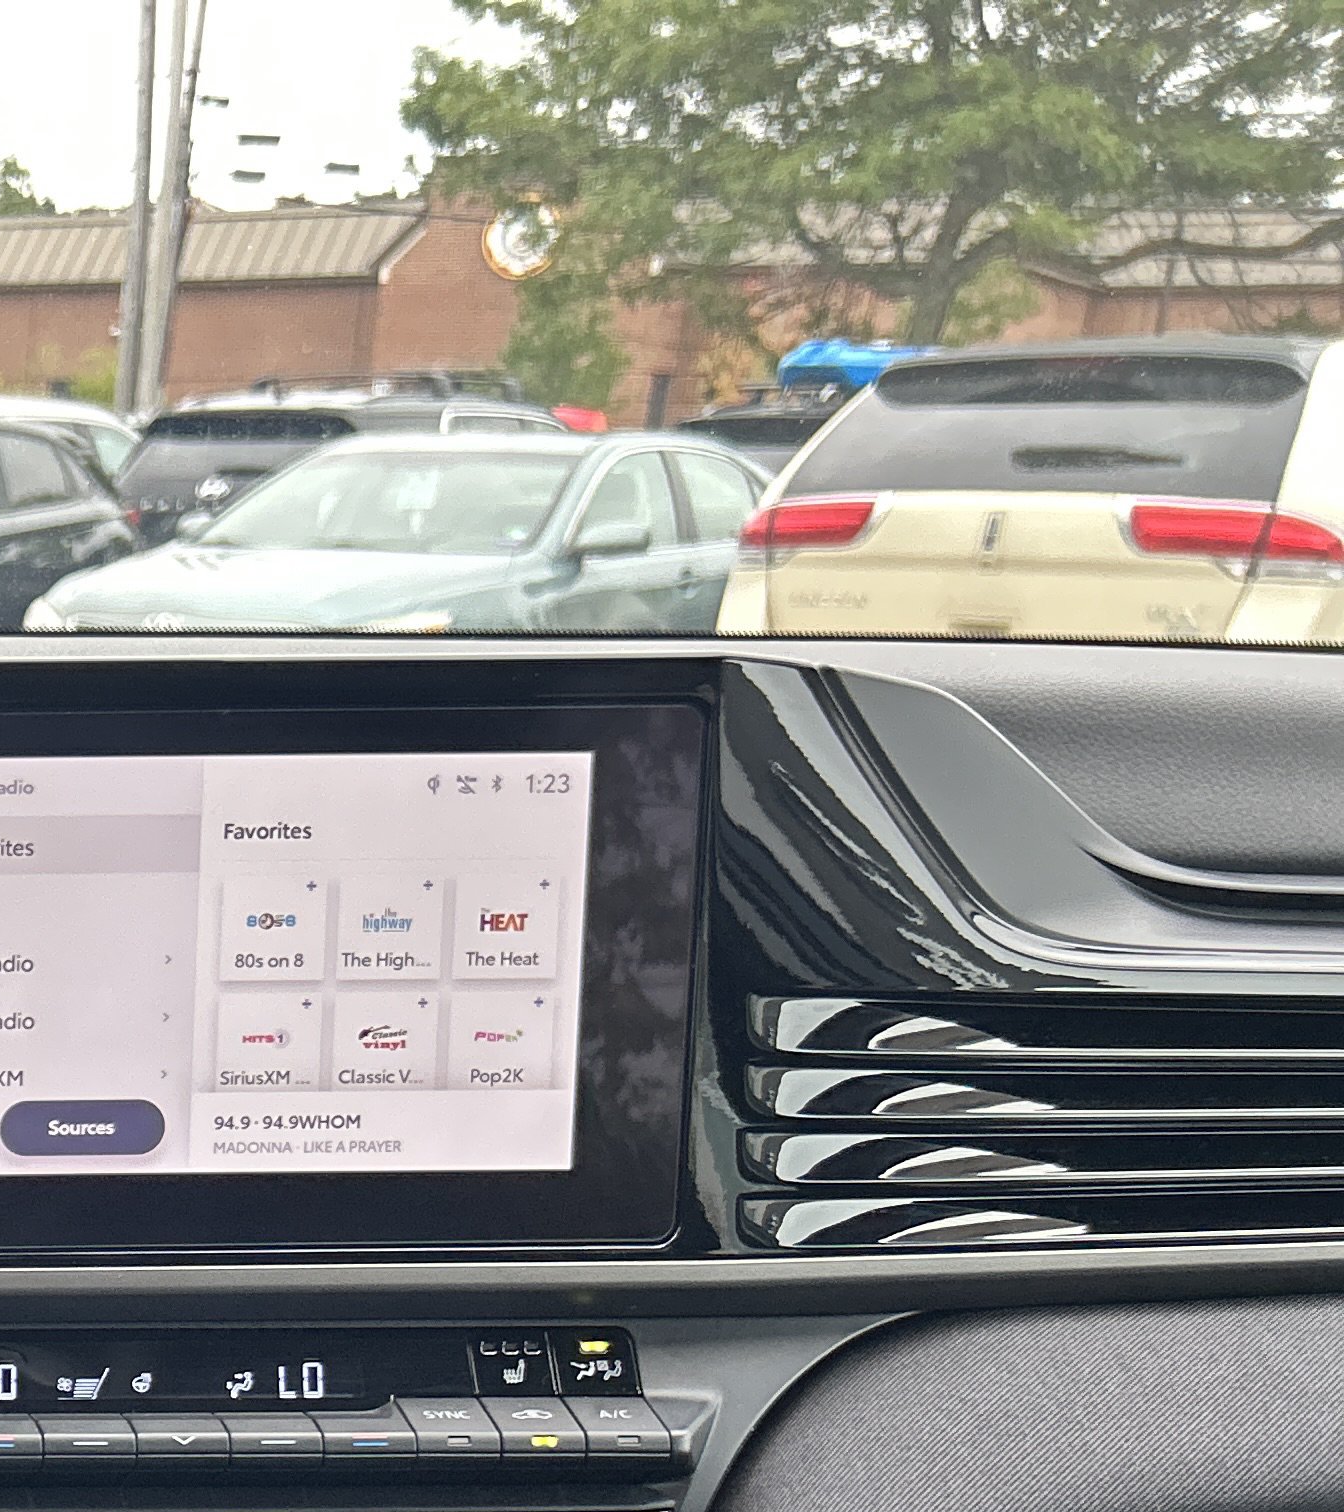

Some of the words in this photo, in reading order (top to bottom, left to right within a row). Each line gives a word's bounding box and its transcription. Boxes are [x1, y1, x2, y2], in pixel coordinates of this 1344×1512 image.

[525, 774, 571, 794] 1:23
[223, 822, 313, 840] Favorites
[362, 913, 412, 932] highway
[479, 913, 528, 932] HEAT
[235, 953, 263, 969] 80s
[268, 957, 290, 969] on
[294, 953, 304, 968] 8
[342, 952, 372, 968] The
[467, 952, 497, 967] The
[501, 951, 540, 967] Heat
[220, 1070, 291, 1086] SiriusXM
[339, 1069, 395, 1085] Classic
[470, 1069, 524, 1087] Pop2K
[48, 1119, 116, 1136] Sources
[214, 1116, 251, 1131] 94.9
[262, 1115, 361, 1130] 94.9WHOM
[213, 1142, 292, 1154] MADONNA
[304, 1141, 333, 1153] LIKE
[335, 1141, 347, 1153] A
[349, 1140, 401, 1153] PRAYER
[423, 1409, 471, 1420] SYNC
